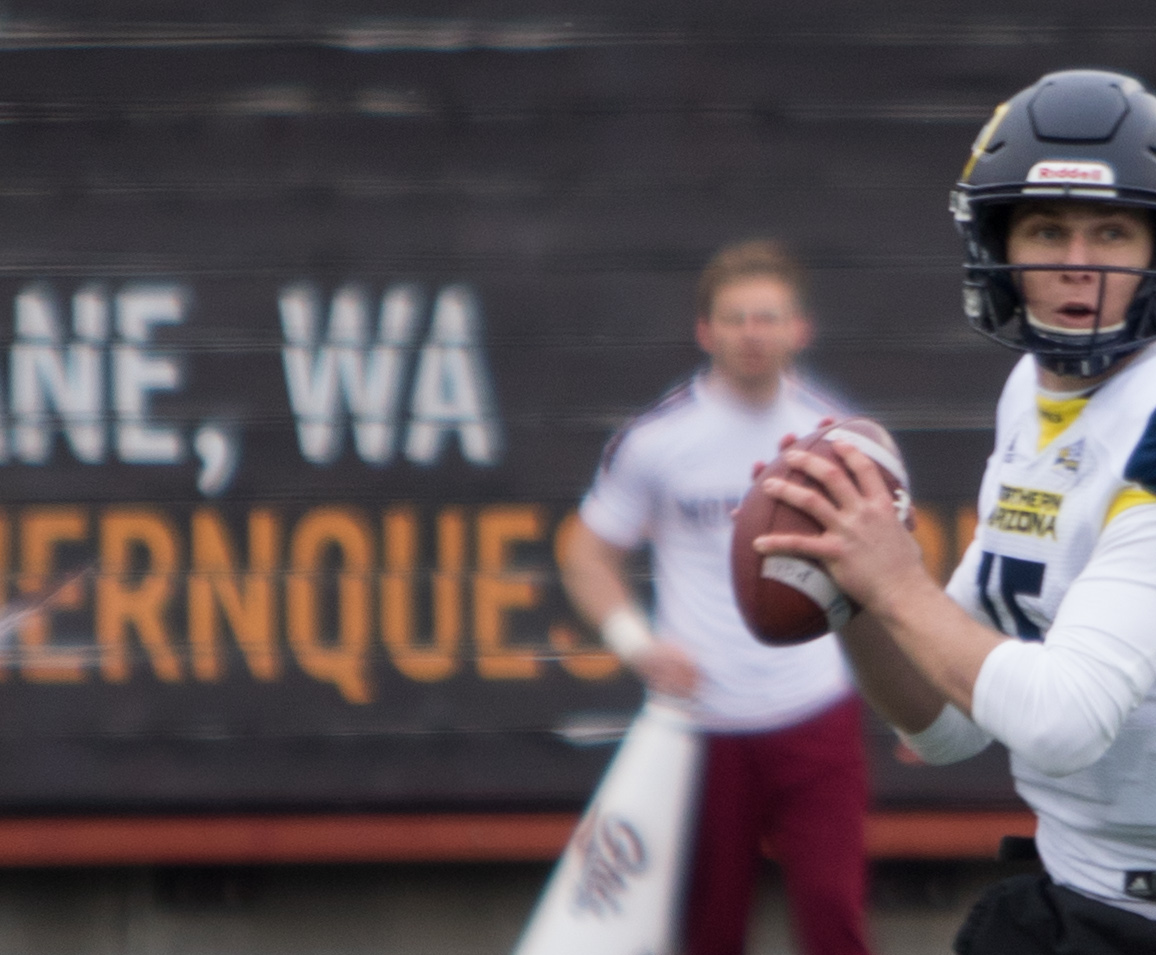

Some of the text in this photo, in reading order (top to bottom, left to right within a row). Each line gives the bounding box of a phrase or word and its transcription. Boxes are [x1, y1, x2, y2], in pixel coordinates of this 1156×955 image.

[1038, 167, 1103, 181] Riddell
[0, 283, 500, 495] NE, WA
[0, 505, 622, 702] ERNQUE
